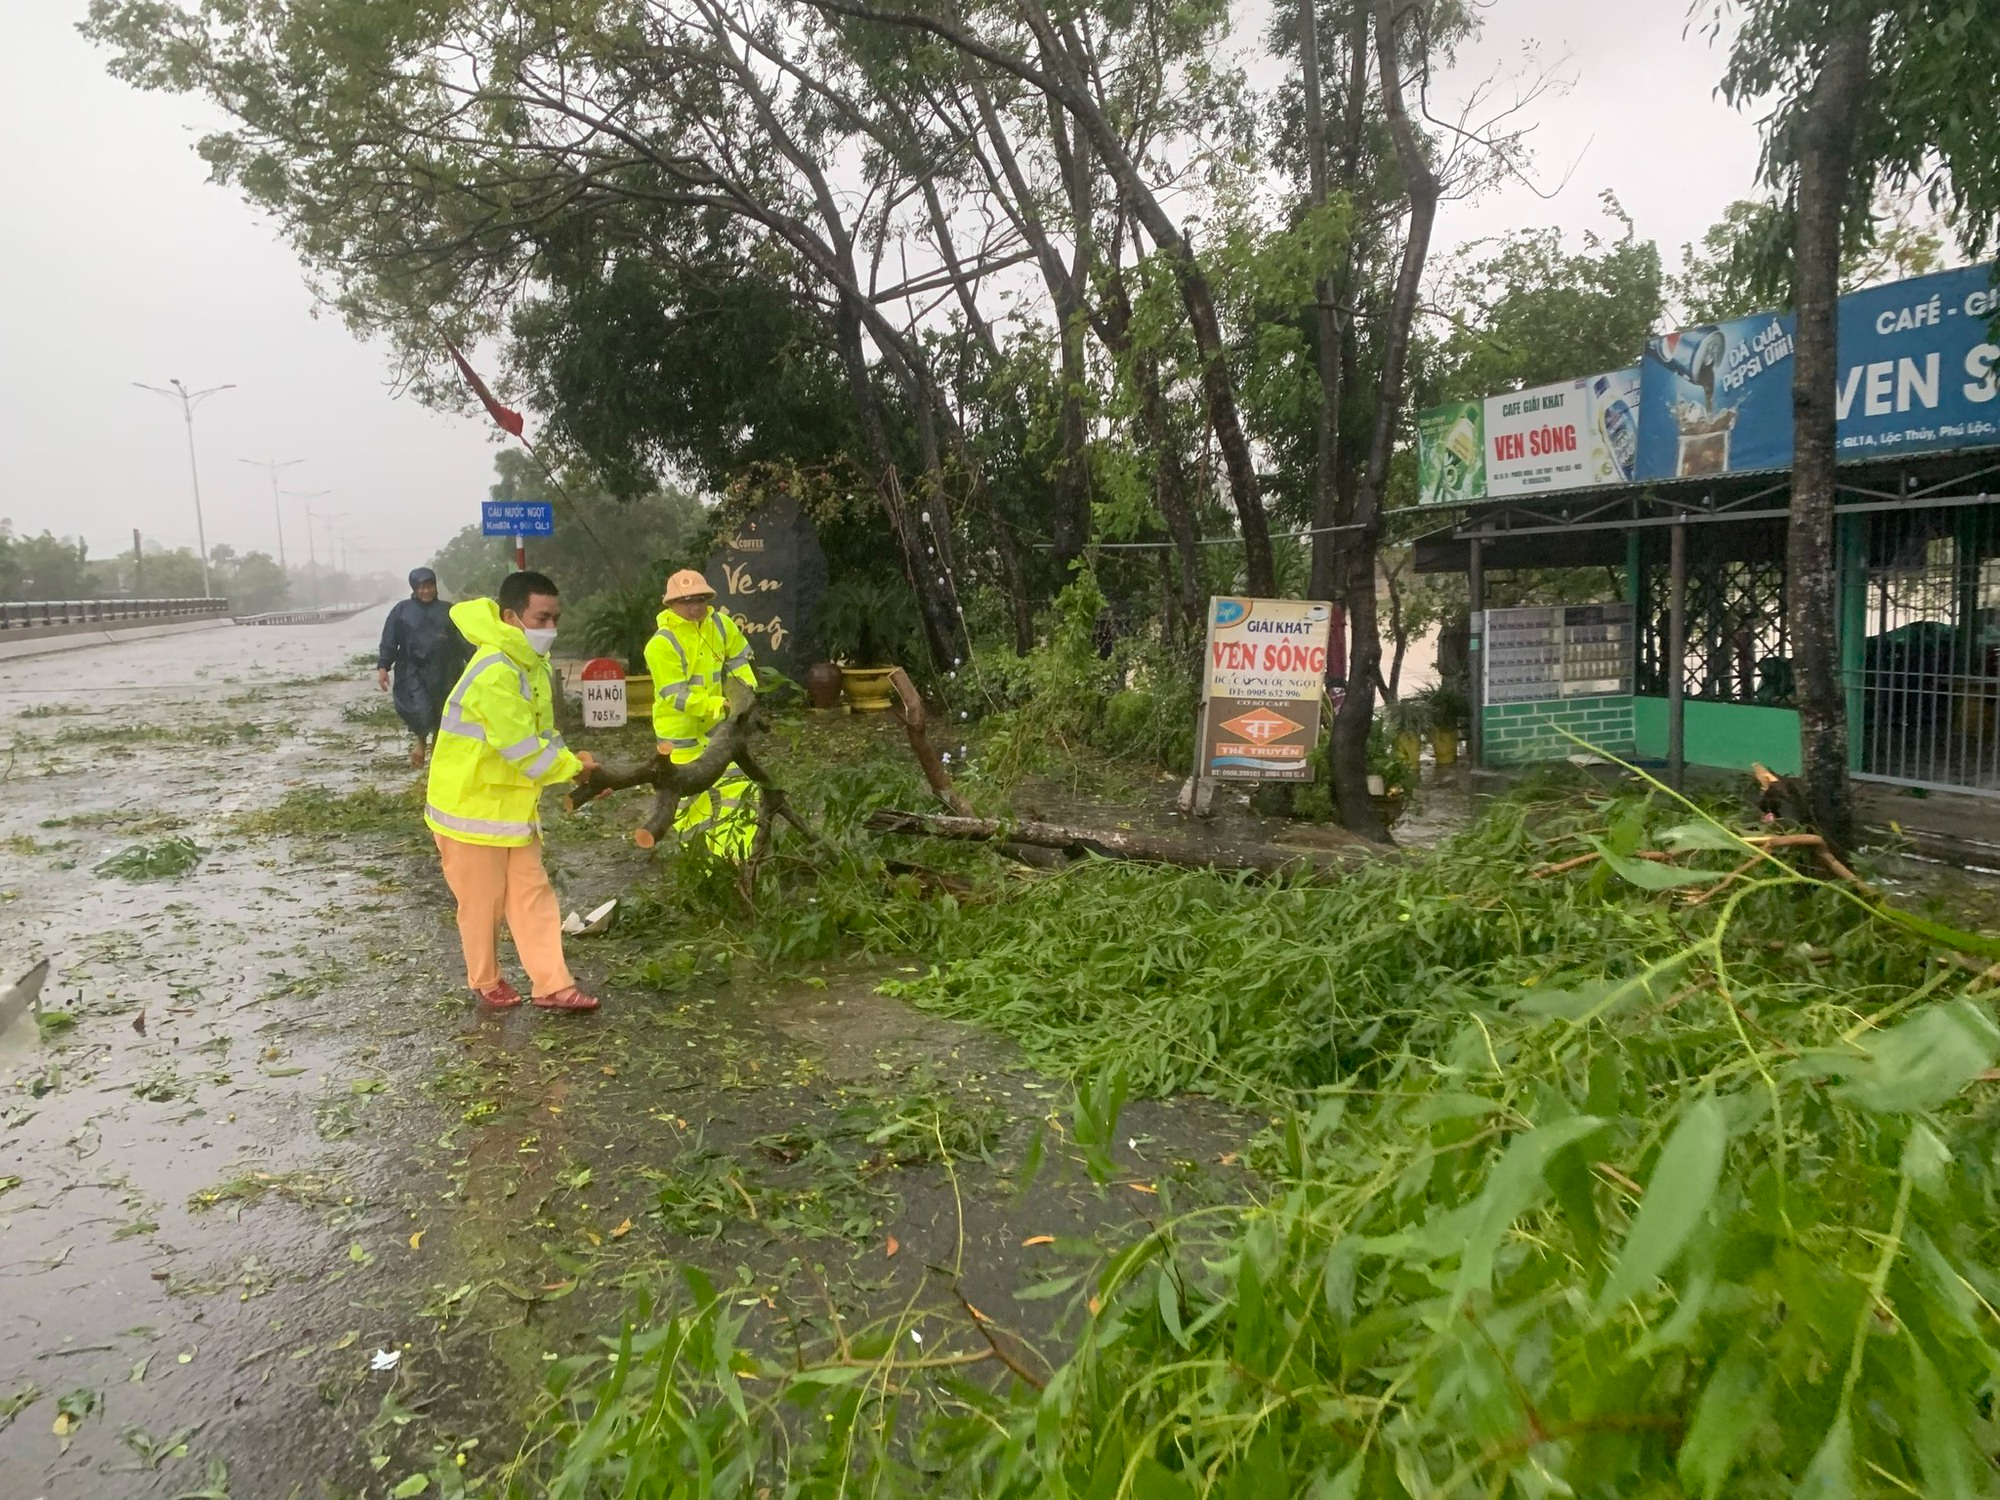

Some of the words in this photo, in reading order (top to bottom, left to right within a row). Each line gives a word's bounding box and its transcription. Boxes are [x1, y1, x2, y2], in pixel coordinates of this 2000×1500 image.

[1875, 293, 1941, 335] CAFÉ
[1753, 317, 1783, 352] QUÁ
[1722, 356, 1763, 392] PEPSI
[1836, 352, 1940, 421] VEN
[1963, 342, 2000, 403] S
[1494, 432, 1525, 462] VEN
[1529, 424, 1577, 457] SÔNG
[1880, 431, 1902, 446] Lộc
[1939, 422, 1964, 437] Phú
[1967, 420, 1997, 437] Lộc,
[504, 504, 525, 518] NƯỚC
[527, 506, 546, 520] NGỌT
[739, 538, 765, 549] COFFEE
[722, 561, 783, 595] Ven
[720, 605, 788, 651] ông
[1263, 636, 1326, 673] SÔNG
[588, 685, 602, 700] HÀ
[604, 685, 622, 702] NỘI
[1268, 690, 1283, 698] 632
